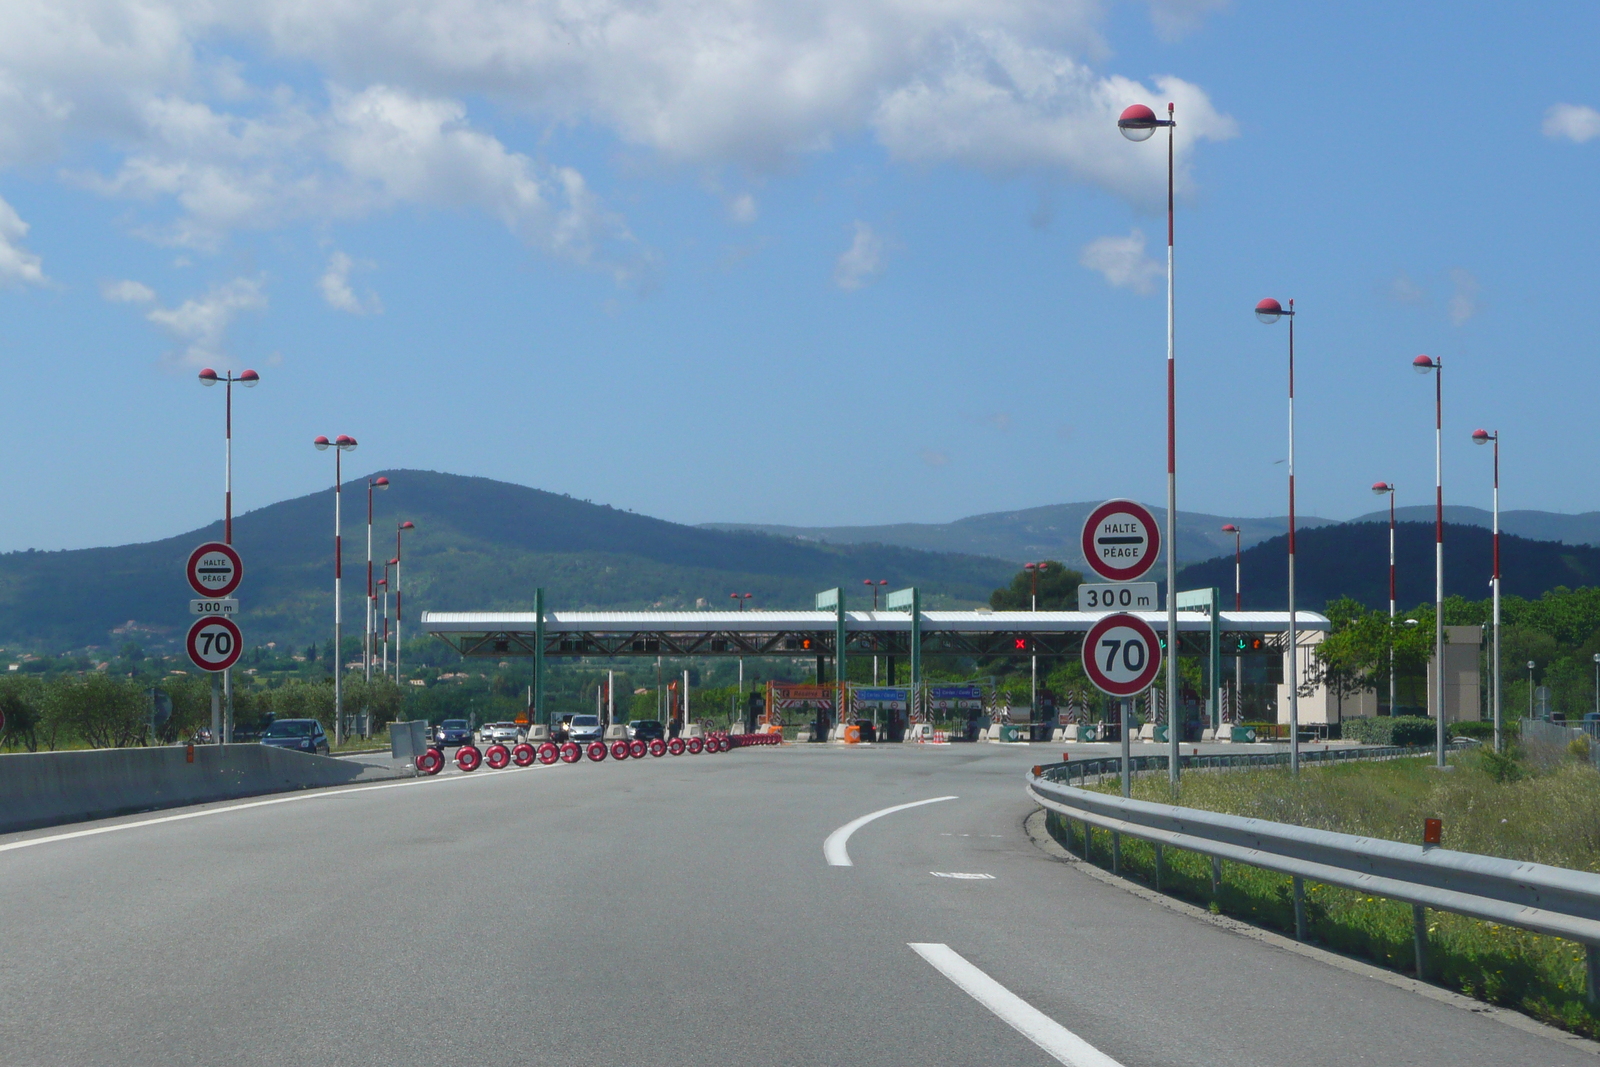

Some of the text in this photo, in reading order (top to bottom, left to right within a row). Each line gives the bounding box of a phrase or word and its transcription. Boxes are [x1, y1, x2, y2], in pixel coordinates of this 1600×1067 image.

[1104, 523, 1137, 533] HALTE
[1103, 546, 1139, 557] PÉAGE
[202, 574, 227, 582] PÉAGE
[1087, 588, 1150, 607] 300 m
[197, 602, 220, 612] 300
[200, 632, 231, 655] 70
[1101, 639, 1145, 672] 70
